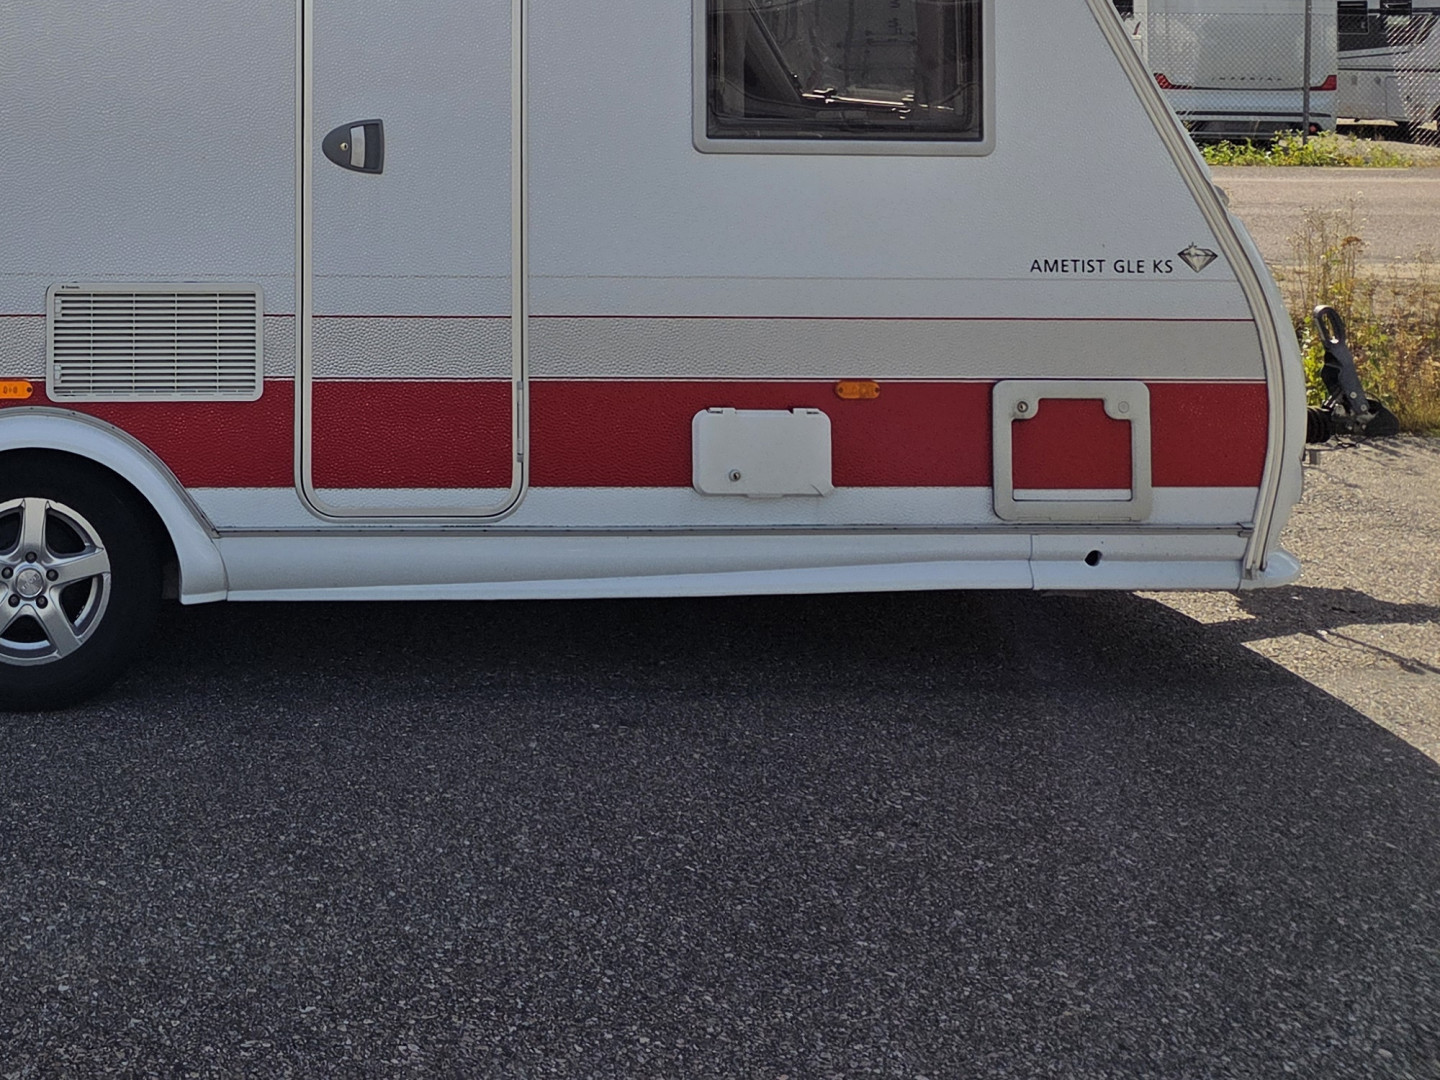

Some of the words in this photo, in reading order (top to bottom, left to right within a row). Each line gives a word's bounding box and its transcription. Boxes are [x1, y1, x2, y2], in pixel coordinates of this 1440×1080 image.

[1030, 259, 1106, 273] AMETIST
[1113, 259, 1145, 273] GLE
[1152, 259, 1173, 274] KS
